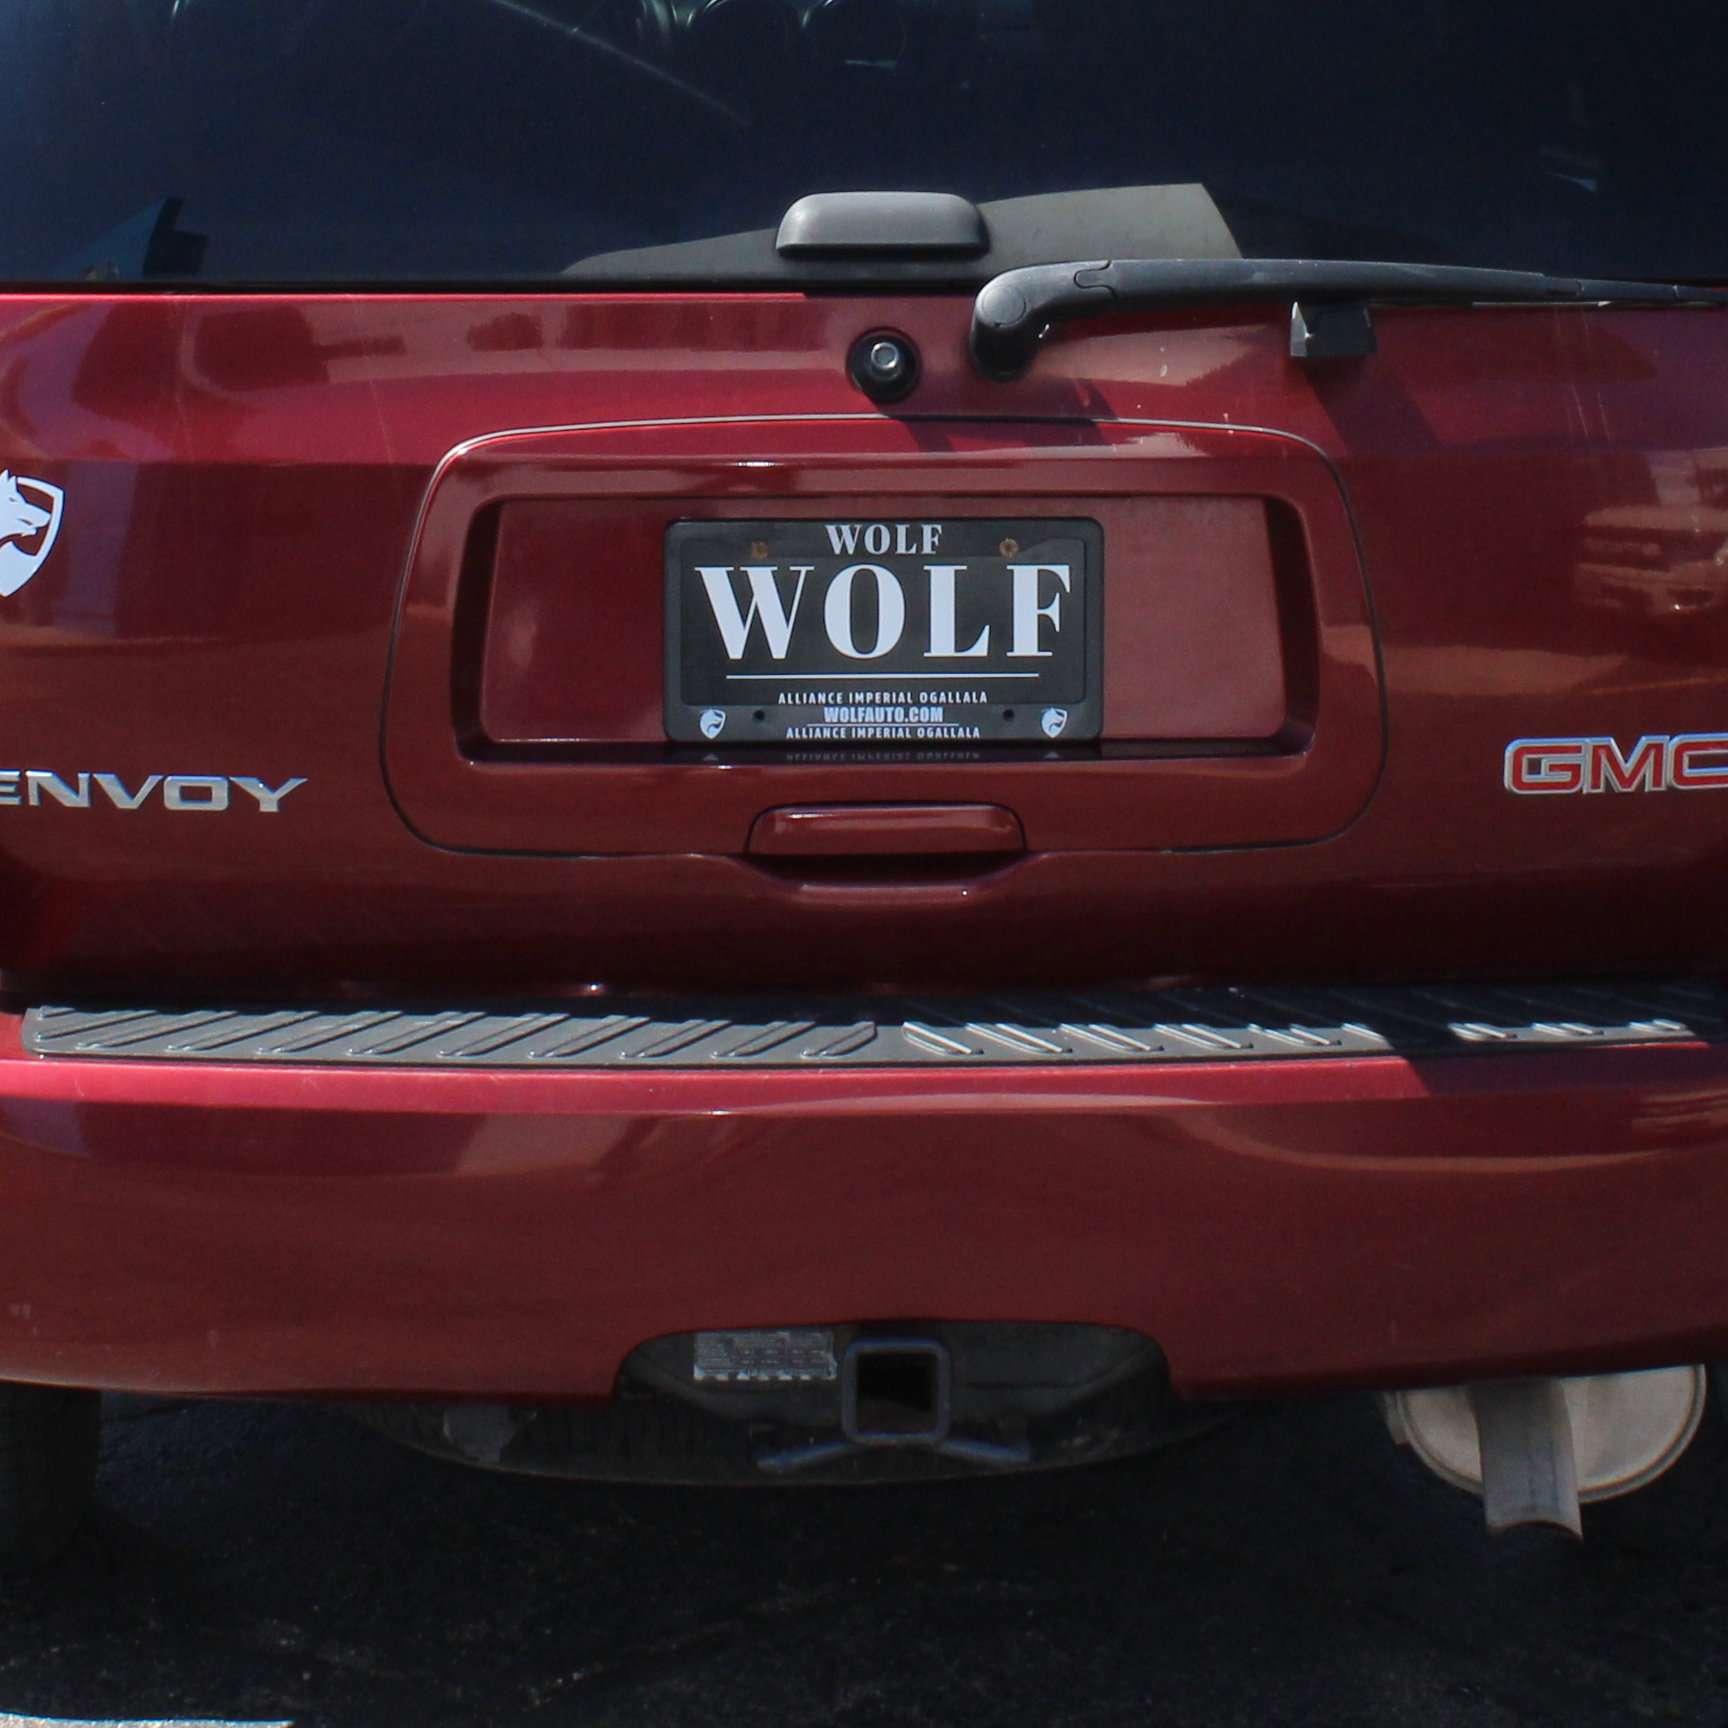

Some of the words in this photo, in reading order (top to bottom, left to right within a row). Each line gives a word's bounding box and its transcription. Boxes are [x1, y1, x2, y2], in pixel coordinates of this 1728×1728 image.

[825, 523, 944, 555] WOLF
[694, 563, 1072, 661] WOLF
[778, 692, 843, 704] ALLIANCE
[848, 692, 913, 704] IMPERIAL
[919, 691, 988, 704] OGALLALA
[823, 706, 944, 723] WOLFAUTO.COM
[786, 727, 846, 739] ALLIANCE
[851, 727, 912, 739] IMPERIAL
[917, 726, 981, 739] OGALLALA
